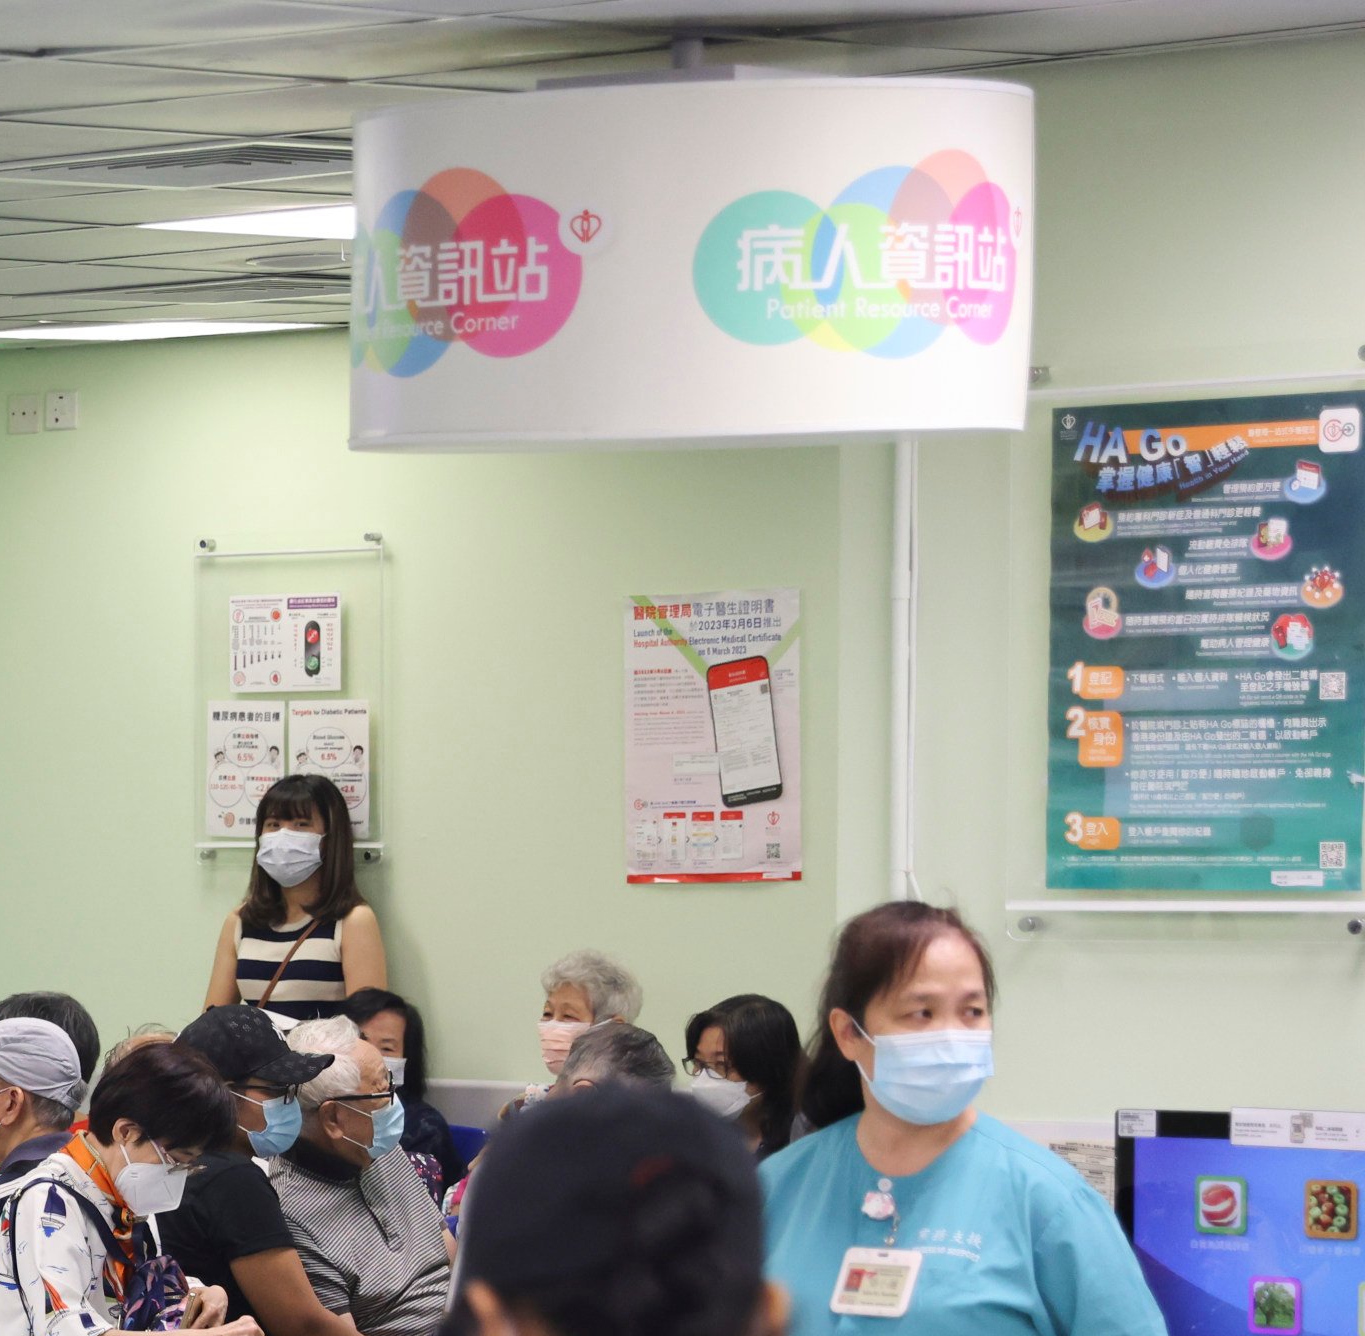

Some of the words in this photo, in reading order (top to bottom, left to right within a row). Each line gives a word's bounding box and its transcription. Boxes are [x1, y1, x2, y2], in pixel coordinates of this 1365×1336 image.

[736, 222, 1007, 293] 病人資訊站
[766, 298, 847, 321] Patient
[854, 297, 940, 320] Resource
[945, 296, 994, 320] Corner
[450, 311, 520, 335] Corner
[1074, 421, 1128, 464] HA
[1139, 427, 1188, 462] Go
[1179, 475, 1205, 490] Health
[1213, 462, 1230, 477] Your
[633, 598, 775, 621] 醫院管理局電子醫生證明書
[633, 629, 655, 638] Launch
[633, 638, 659, 649] Hospital
[689, 636, 720, 646] Electronic
[721, 634, 747, 645] Medical
[747, 633, 782, 643] Certificate
[712, 646, 731, 656] March
[212, 711, 281, 723] 糖尿病患者的目標
[292, 708, 313, 717] Targets
[321, 708, 343, 716] Diabetic
[344, 707, 367, 715] Patients
[1067, 707, 1086, 738] 2
[236, 752, 255, 762] 6.5%
[320, 752, 338, 762] 6.5%
[1065, 812, 1083, 842] 3
